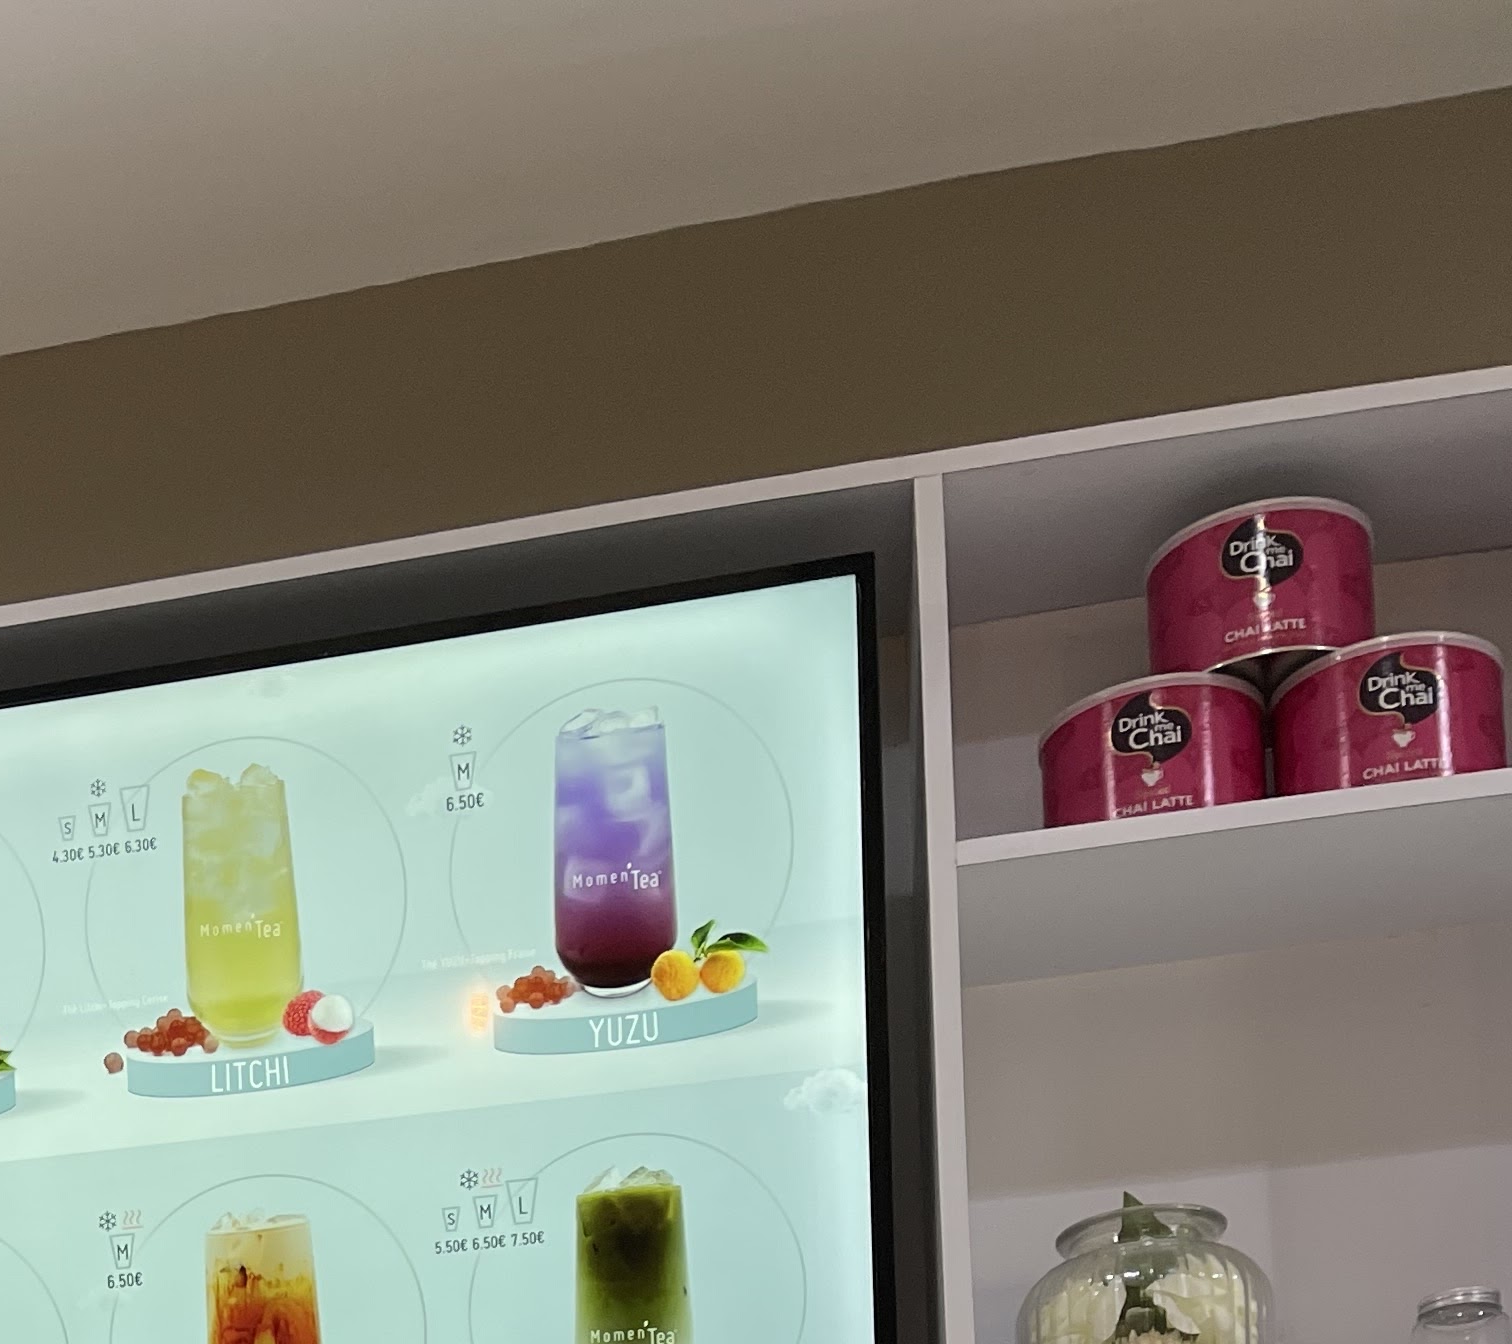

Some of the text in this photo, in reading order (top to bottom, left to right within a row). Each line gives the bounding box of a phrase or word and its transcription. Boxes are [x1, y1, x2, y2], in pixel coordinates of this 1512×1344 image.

[1224, 624, 1260, 643] CHAI
[1368, 671, 1421, 692] Drink
[1378, 686, 1434, 710] Chai
[1118, 711, 1170, 733] Drink
[1129, 725, 1182, 750] Chai
[456, 761, 471, 782] M
[1362, 762, 1400, 780] CHAI
[445, 791, 486, 813] 6.50€
[1152, 794, 1194, 810] LATTE
[63, 803, 141, 835] S M L
[52, 836, 158, 864] 4.30€ 5.30€ 6.30€
[588, 1011, 660, 1049] YUZU
[210, 1056, 290, 1093] LITCHI
[447, 1196, 529, 1226] S M L
[116, 1243, 129, 1262] M
[434, 1230, 545, 1255] 5.50€ 6.50€ 7.50€
[106, 1271, 144, 1289] 6.50€
